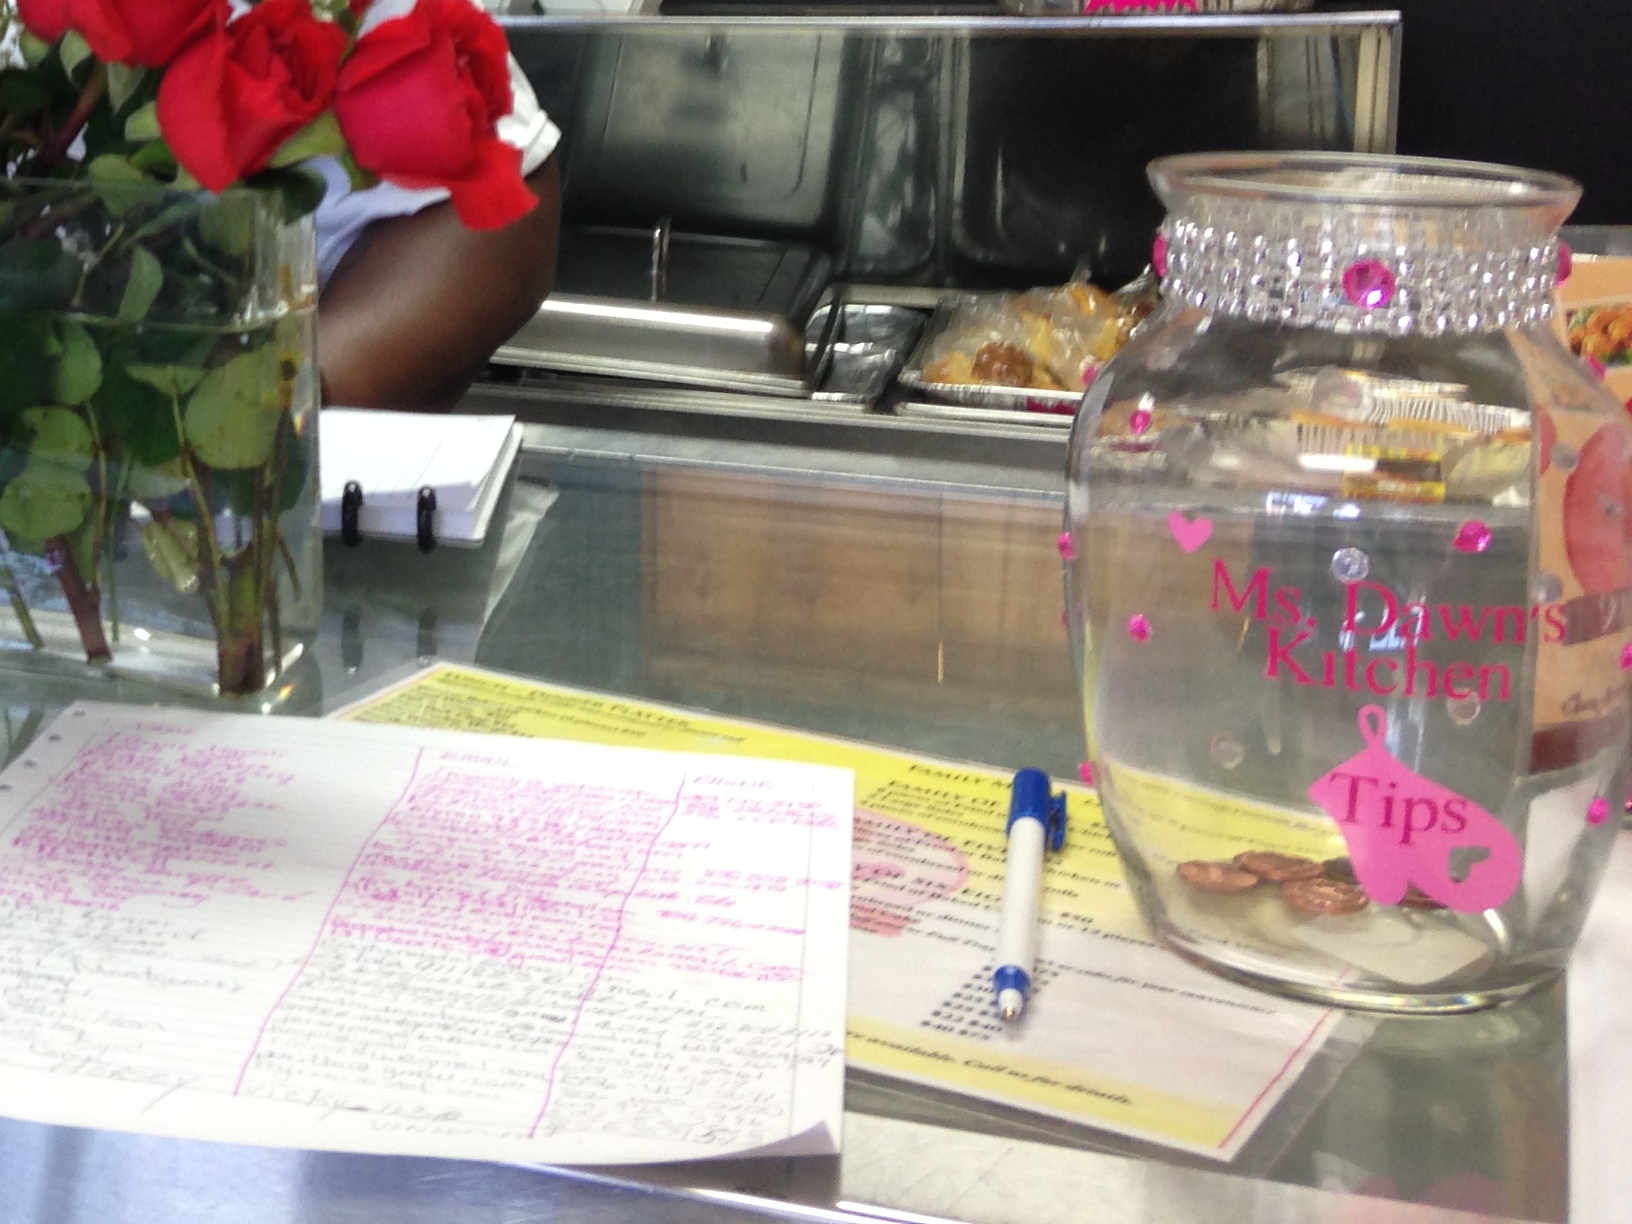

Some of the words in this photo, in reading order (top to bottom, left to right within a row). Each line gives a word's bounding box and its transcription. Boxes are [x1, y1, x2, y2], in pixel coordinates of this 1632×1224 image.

[1210, 559, 1316, 630] Ms.
[1344, 582, 1568, 647] Dawn's
[1265, 624, 1513, 702] Kitchen
[1330, 772, 1469, 839] Tips
